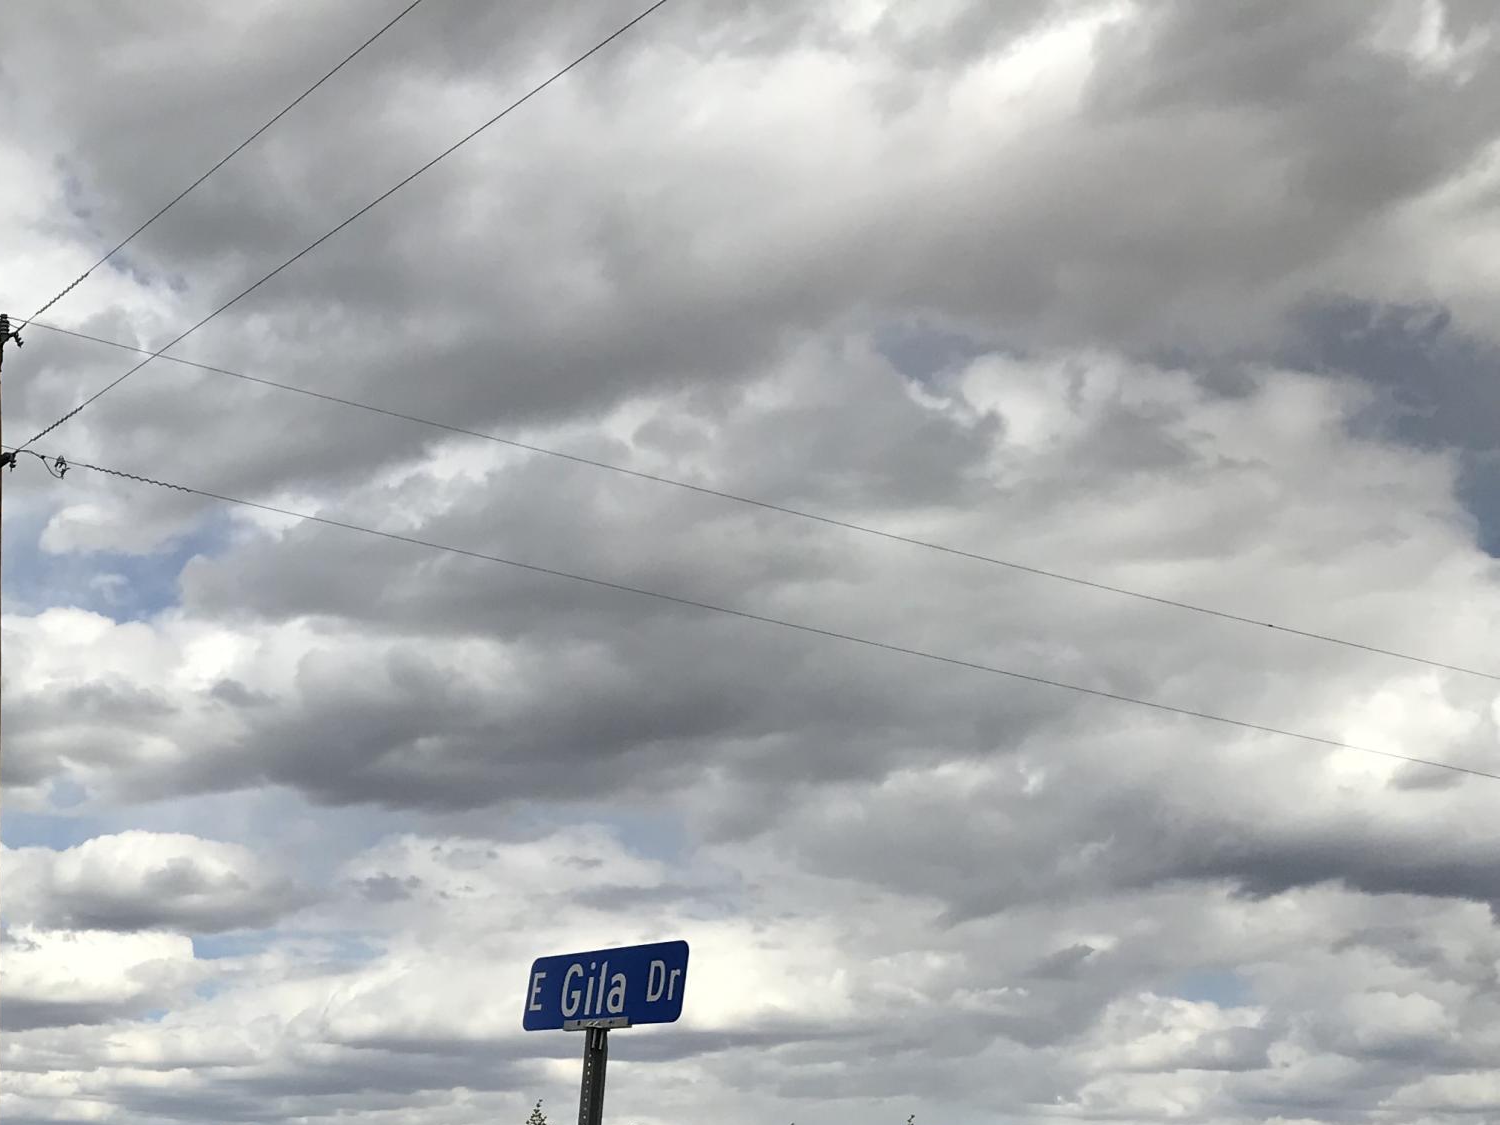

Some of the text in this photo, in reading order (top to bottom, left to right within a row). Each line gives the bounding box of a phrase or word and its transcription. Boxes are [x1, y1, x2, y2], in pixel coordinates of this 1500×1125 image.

[528, 959, 681, 1018] E Gila Dr
